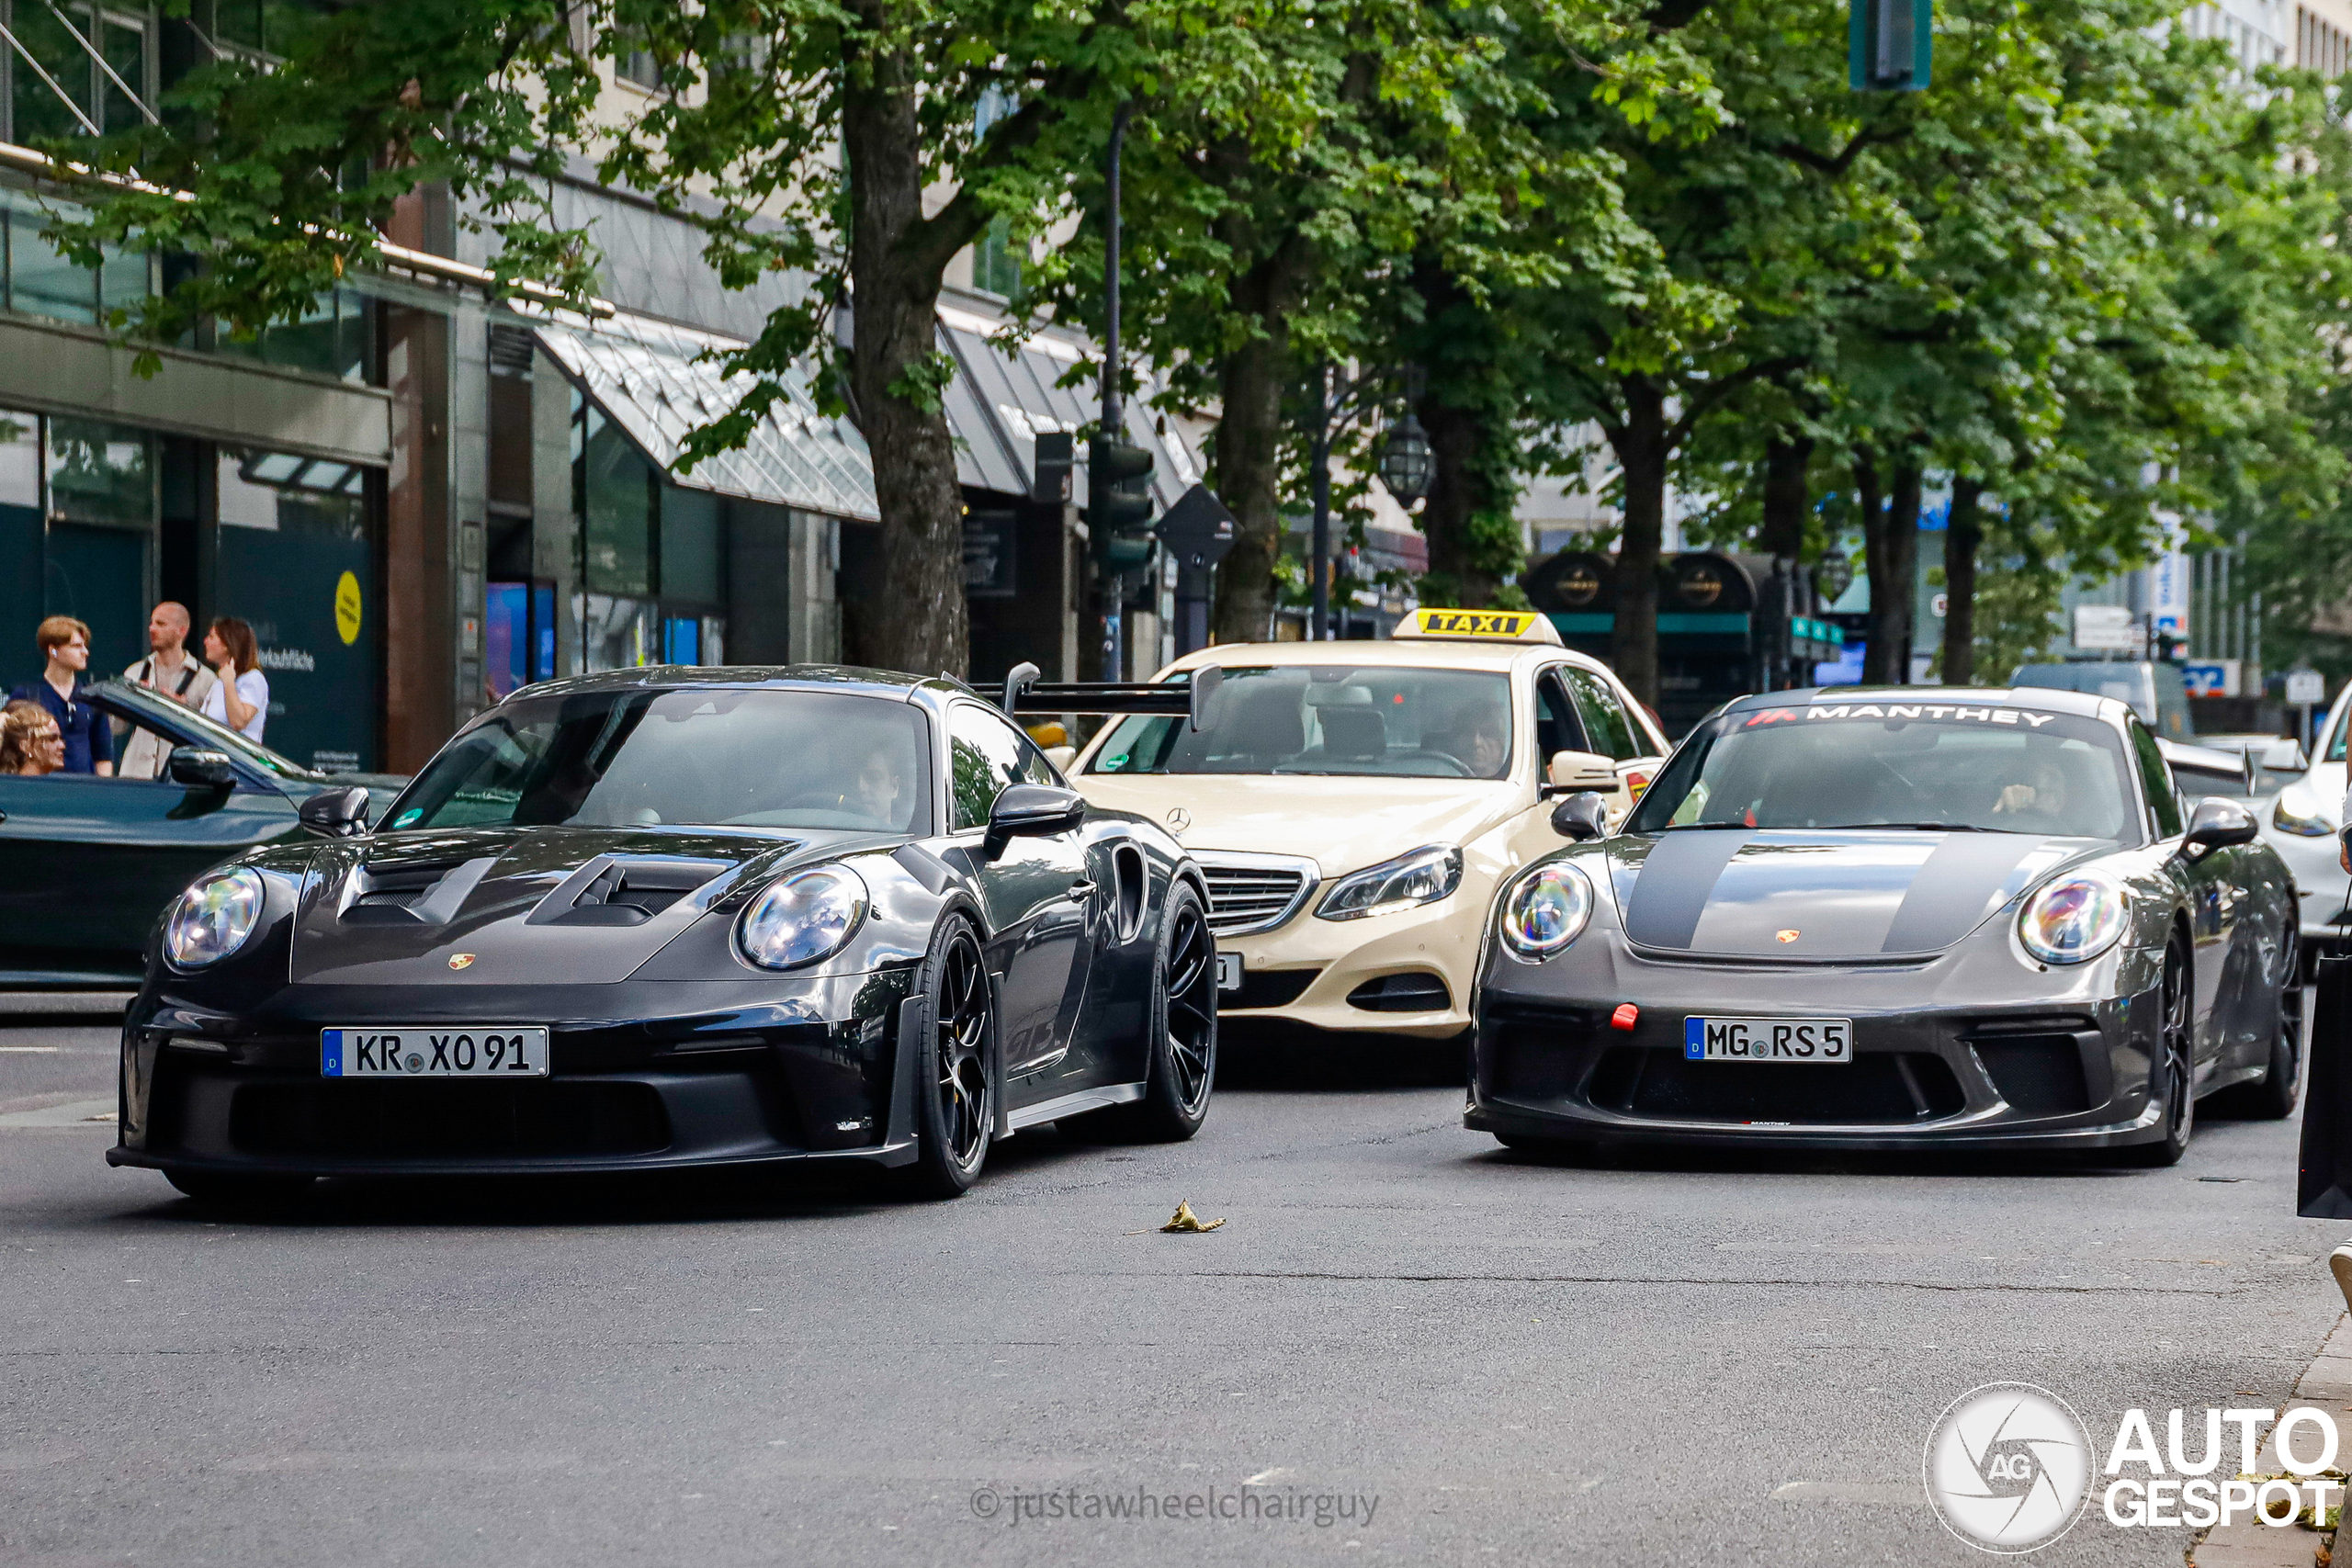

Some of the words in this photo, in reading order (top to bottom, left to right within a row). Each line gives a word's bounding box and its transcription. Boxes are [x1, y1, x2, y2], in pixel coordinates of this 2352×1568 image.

[1438, 615, 1510, 632] TAXI
[1807, 705, 2054, 728] MANTHEY
[328, 1058, 337, 1069] D
[356, 1035, 402, 1071] KR
[484, 1034, 529, 1070] 91
[1691, 1043, 1700, 1053] D
[1707, 1024, 1749, 1055] MG
[1772, 1025, 1815, 1057] RS
[1824, 1026, 1844, 1057] 5
